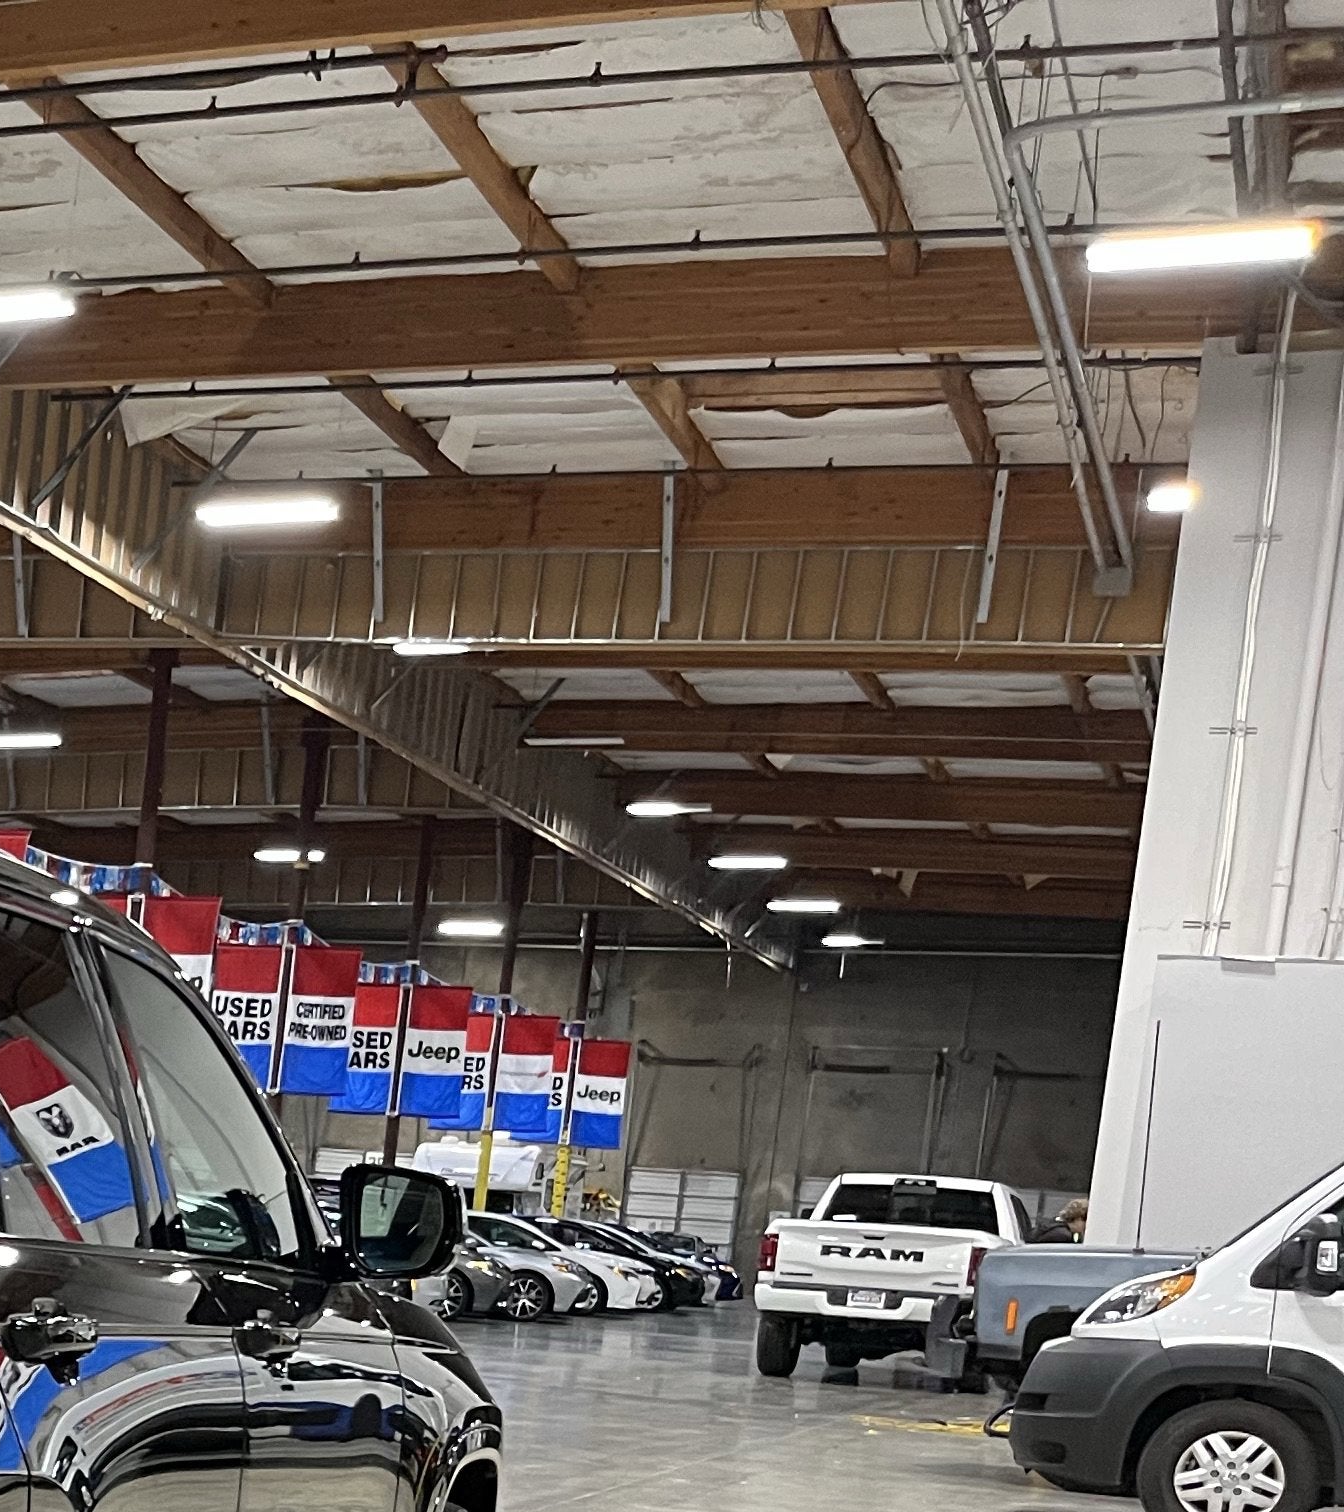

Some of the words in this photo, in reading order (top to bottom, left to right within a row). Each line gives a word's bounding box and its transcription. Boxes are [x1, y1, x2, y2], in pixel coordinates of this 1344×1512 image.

[215, 996, 272, 1018] USED
[296, 1002, 345, 1020] CERTIFIED
[217, 1018, 270, 1040] ARS
[288, 1022, 347, 1042] PRE-OWNED
[352, 1031, 393, 1050] SED
[348, 1051, 390, 1069] ARS
[408, 1041, 460, 1063] Jeep
[577, 1085, 621, 1105] Jeep
[820, 1245, 924, 1263] RAM
